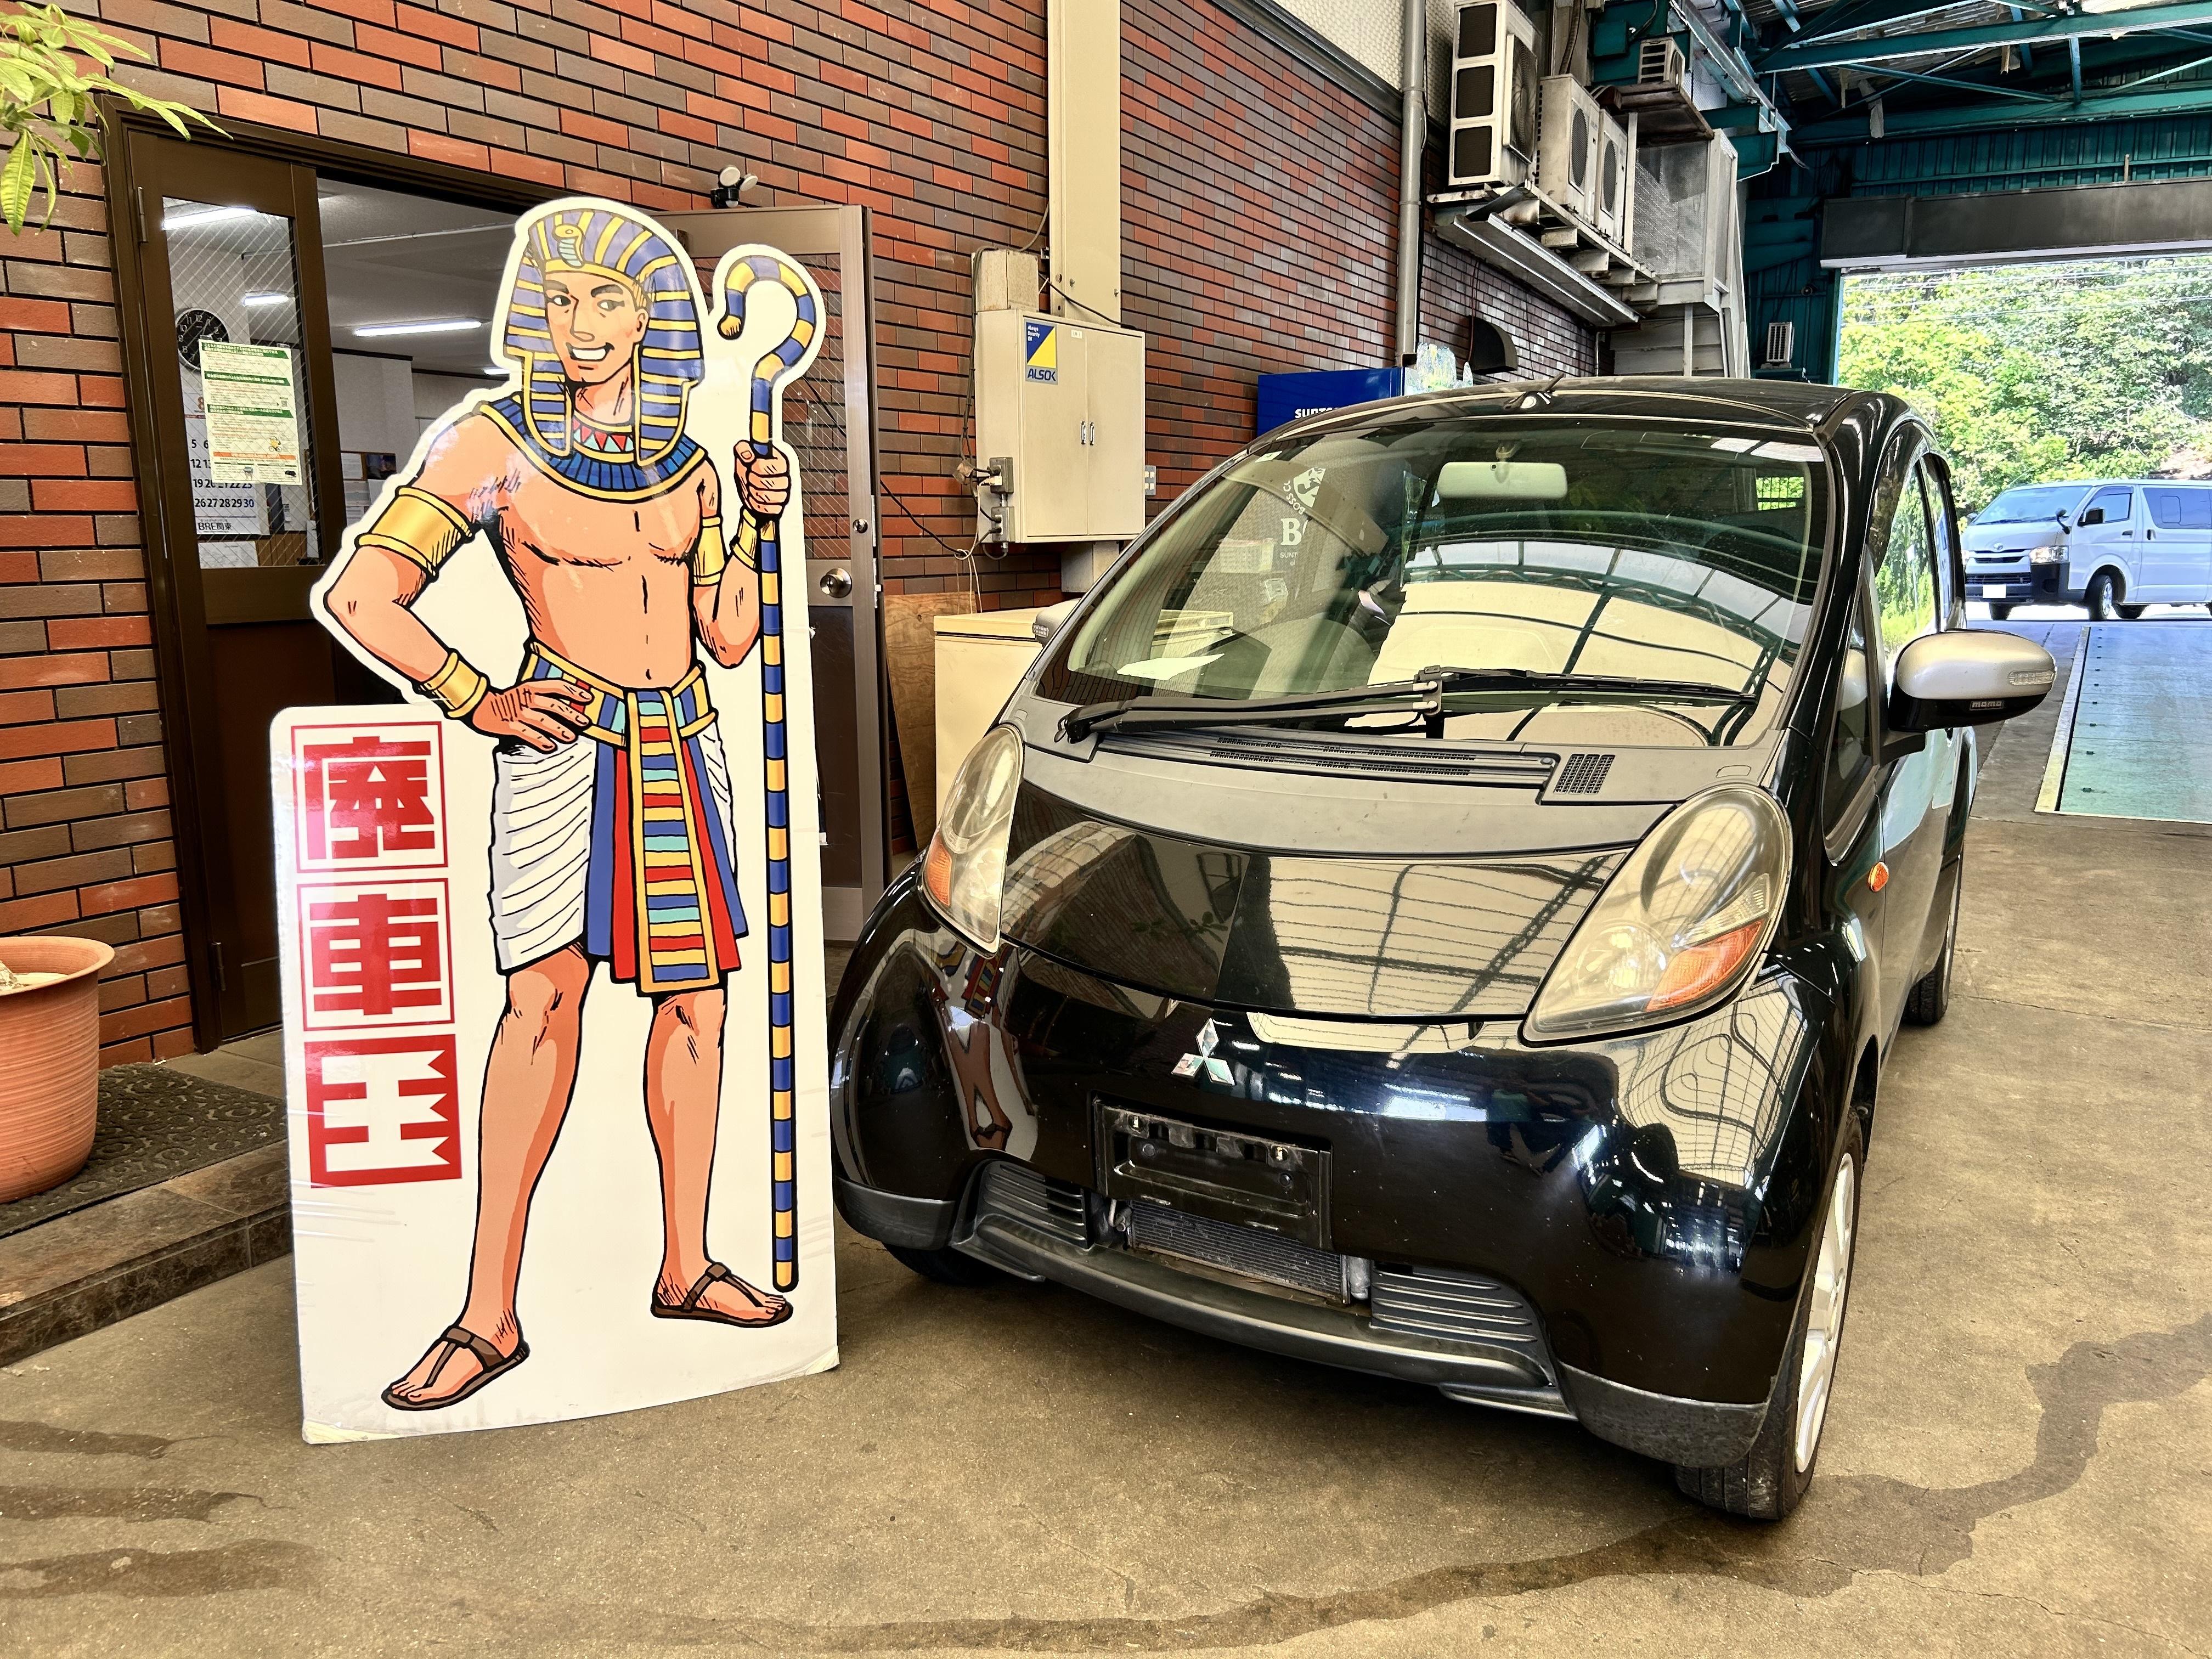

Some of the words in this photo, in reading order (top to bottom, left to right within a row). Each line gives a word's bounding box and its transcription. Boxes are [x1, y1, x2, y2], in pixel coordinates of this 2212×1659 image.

[1027, 368, 1056, 382] ALSOK
[191, 439, 197, 449] 5
[204, 440, 208, 449] 6
[190, 459, 201, 468] 12
[193, 478, 203, 488] 19
[195, 498, 206, 507] 26
[207, 498, 218, 507] 27
[219, 498, 230, 507] 28
[232, 498, 242, 507] 29
[244, 499, 254, 507] 30
[1286, 493, 1306, 515] BOSS
[1280, 518, 1308, 545] B
[301, 734, 451, 1174] 廃車王
